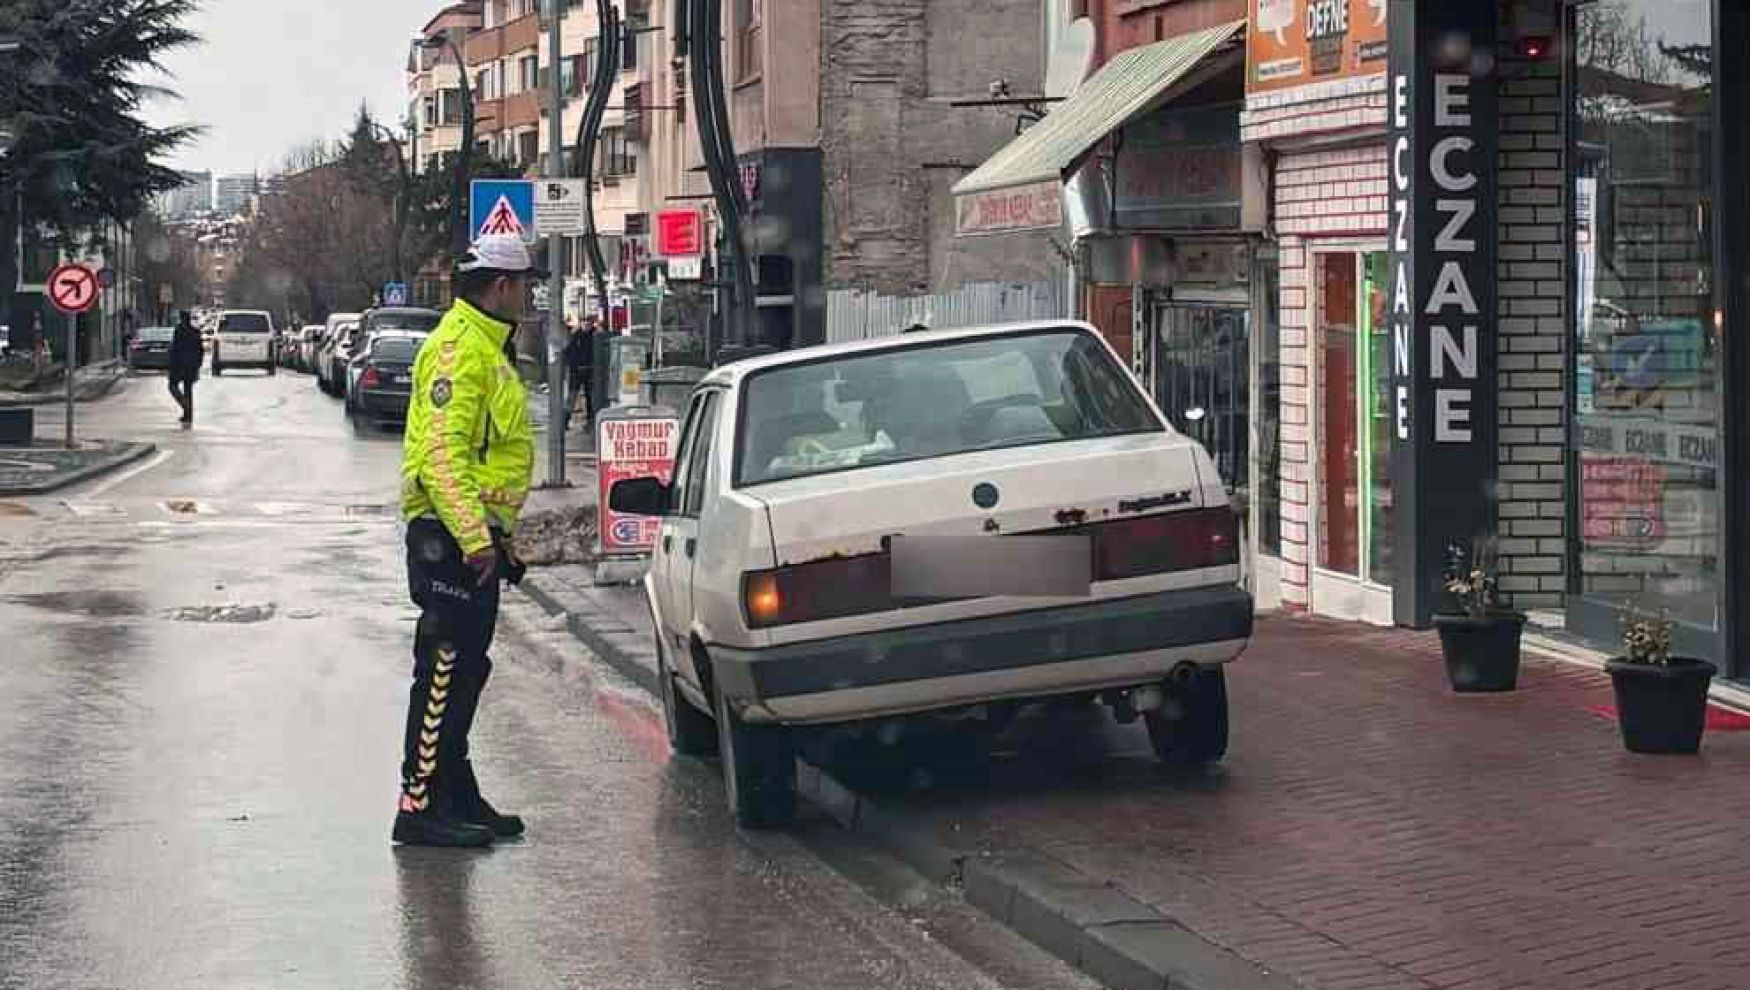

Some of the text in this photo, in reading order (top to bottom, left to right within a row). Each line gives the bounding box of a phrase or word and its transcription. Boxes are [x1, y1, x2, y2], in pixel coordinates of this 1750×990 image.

[1305, 0, 1349, 38] DEFNE
[1393, 75, 1411, 440] ECZANE
[1424, 73, 1480, 443] ECZANE
